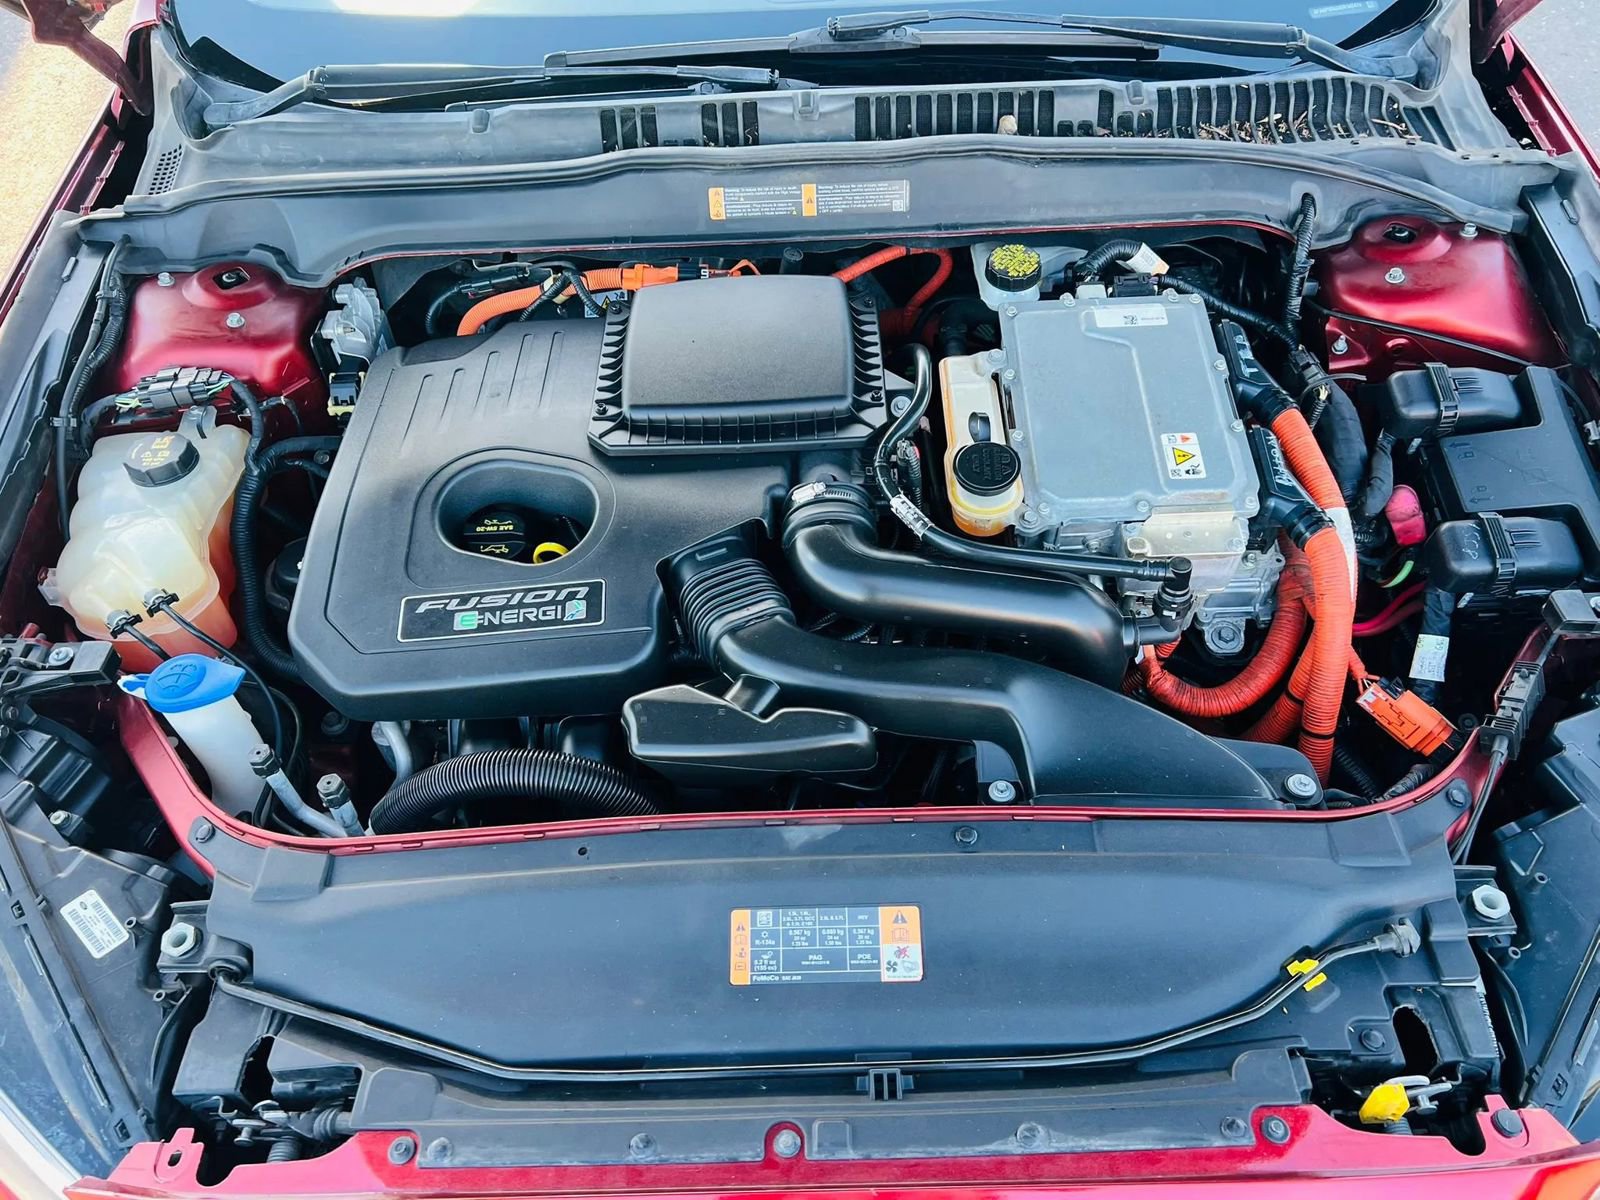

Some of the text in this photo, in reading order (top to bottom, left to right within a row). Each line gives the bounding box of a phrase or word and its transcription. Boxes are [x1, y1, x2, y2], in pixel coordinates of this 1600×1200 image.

[415, 586, 590, 614] FUSION
[454, 604, 562, 631] ENERGI
[752, 974, 779, 982] FoMoCo
